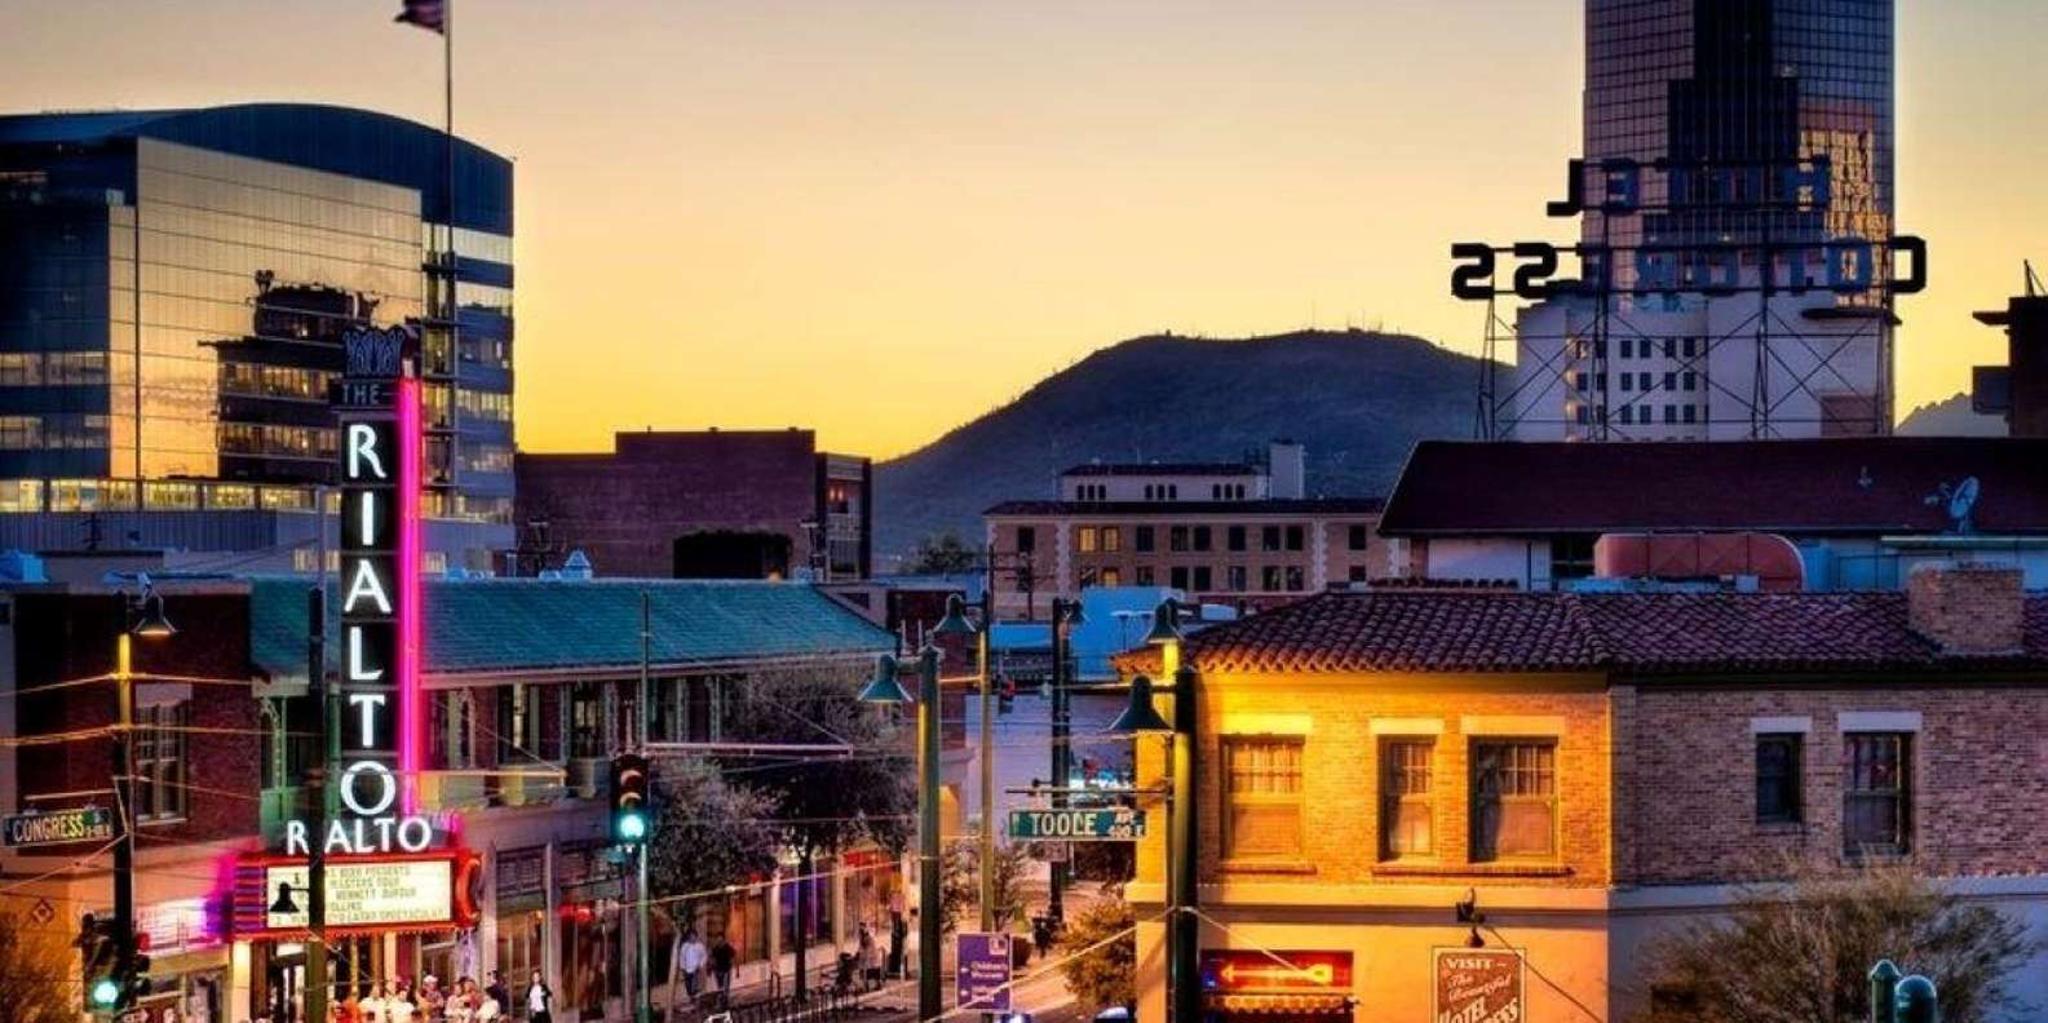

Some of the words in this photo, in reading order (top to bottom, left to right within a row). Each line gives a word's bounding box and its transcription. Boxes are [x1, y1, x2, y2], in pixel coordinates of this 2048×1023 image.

[343, 384, 380, 405] THE
[341, 424, 396, 815] RIALTO
[13, 814, 85, 842] CONGRESS
[287, 817, 432, 855] RALTO
[1029, 812, 1097, 836] TOOLE
[1446, 958, 1493, 970] VISIT
